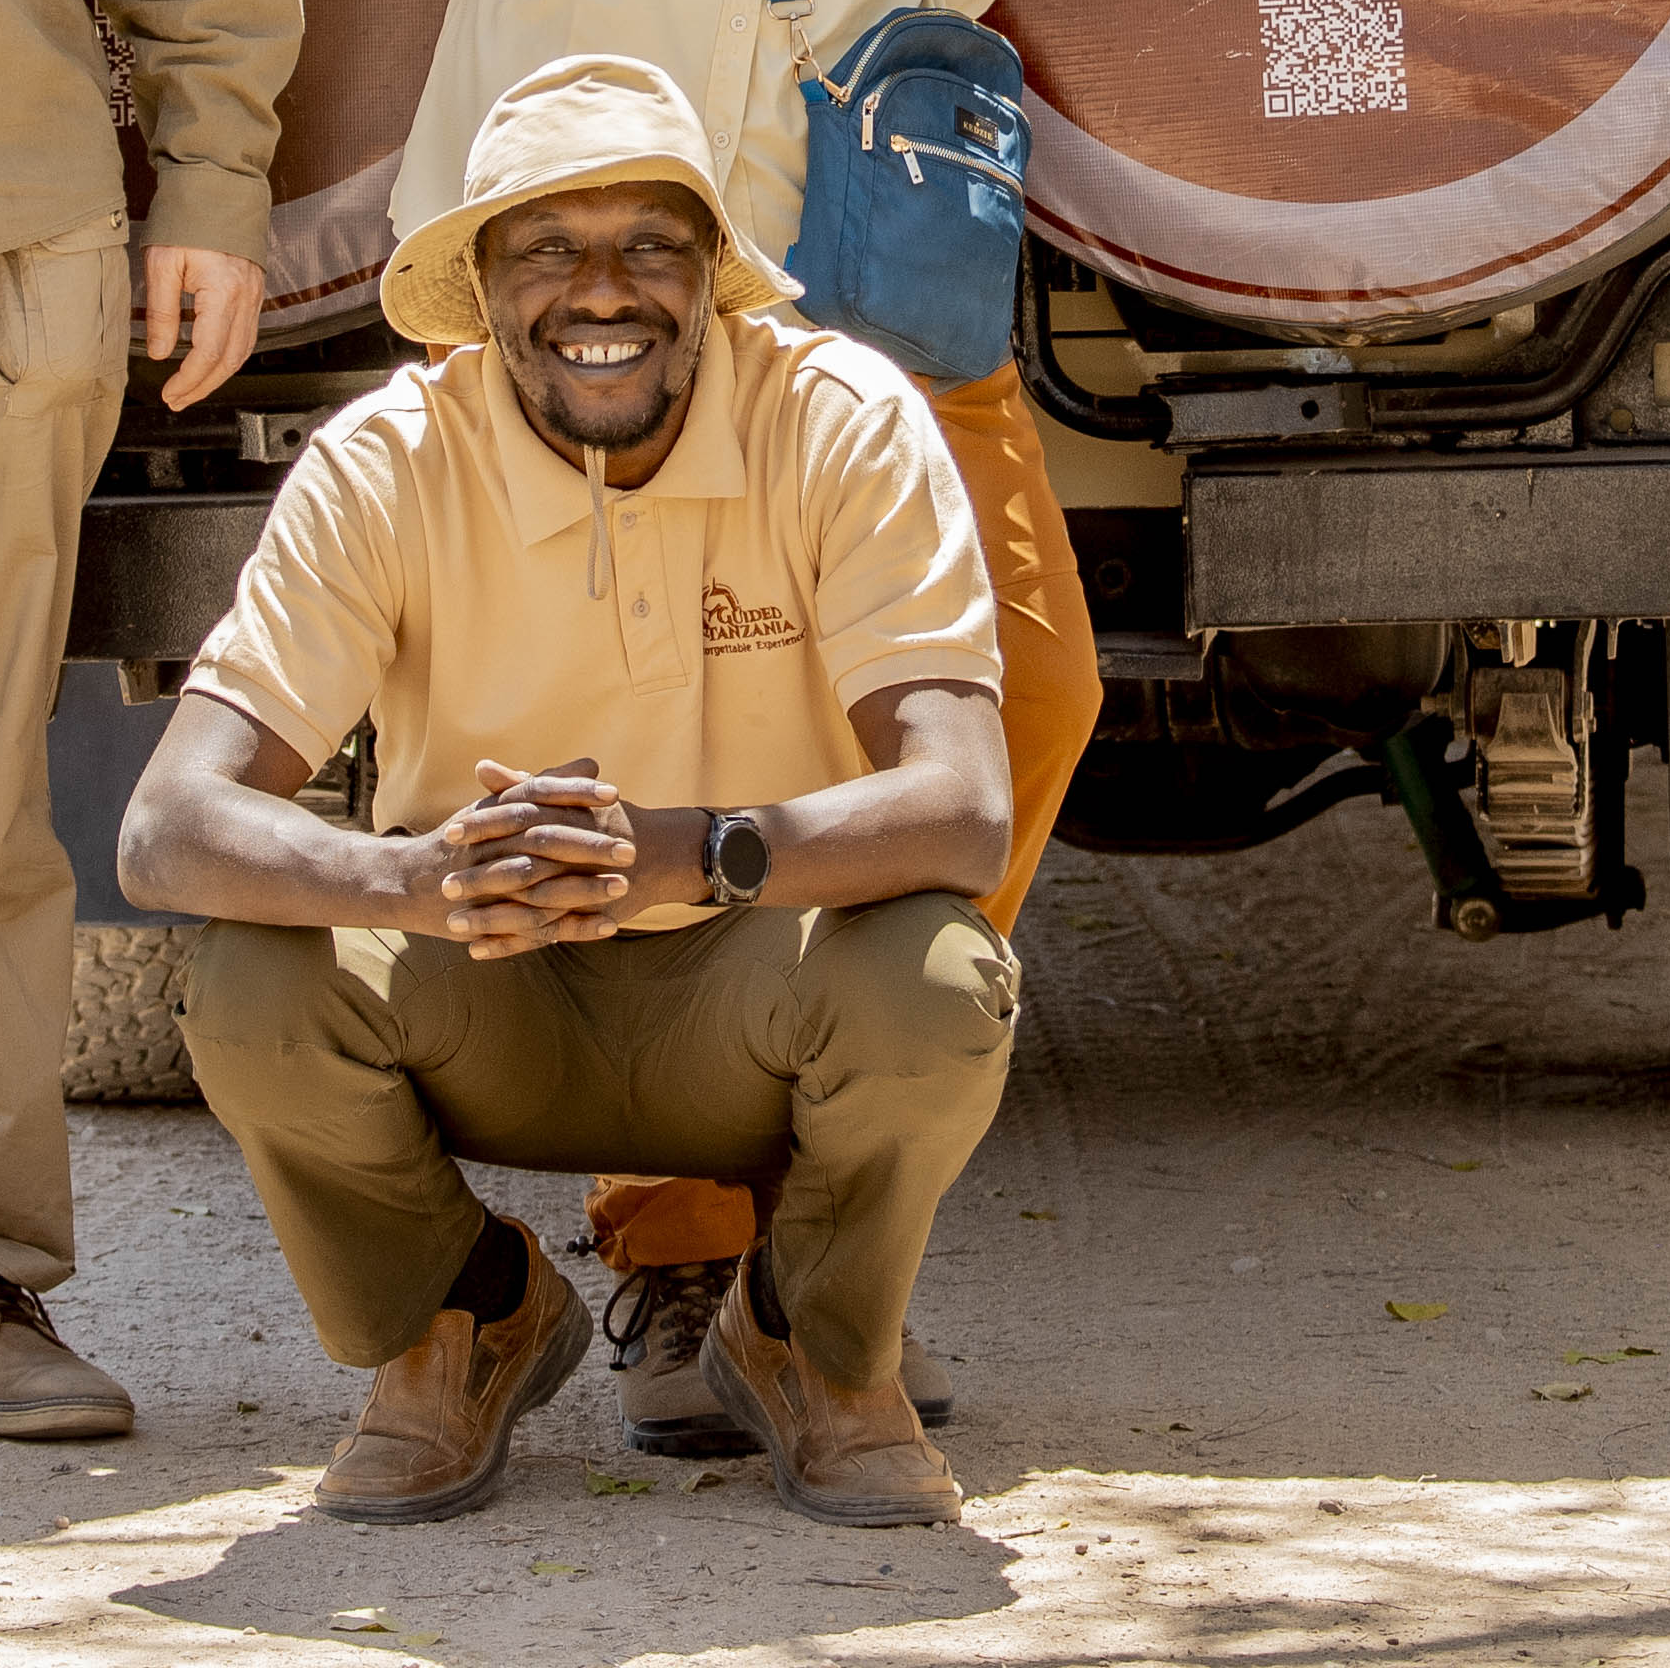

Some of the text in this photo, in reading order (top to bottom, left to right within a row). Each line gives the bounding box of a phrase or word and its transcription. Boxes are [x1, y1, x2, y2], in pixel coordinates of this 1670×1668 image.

[717, 606, 783, 626] GUIDED
[708, 619, 798, 642] TANZANIA
[704, 643, 753, 657] orgettable
